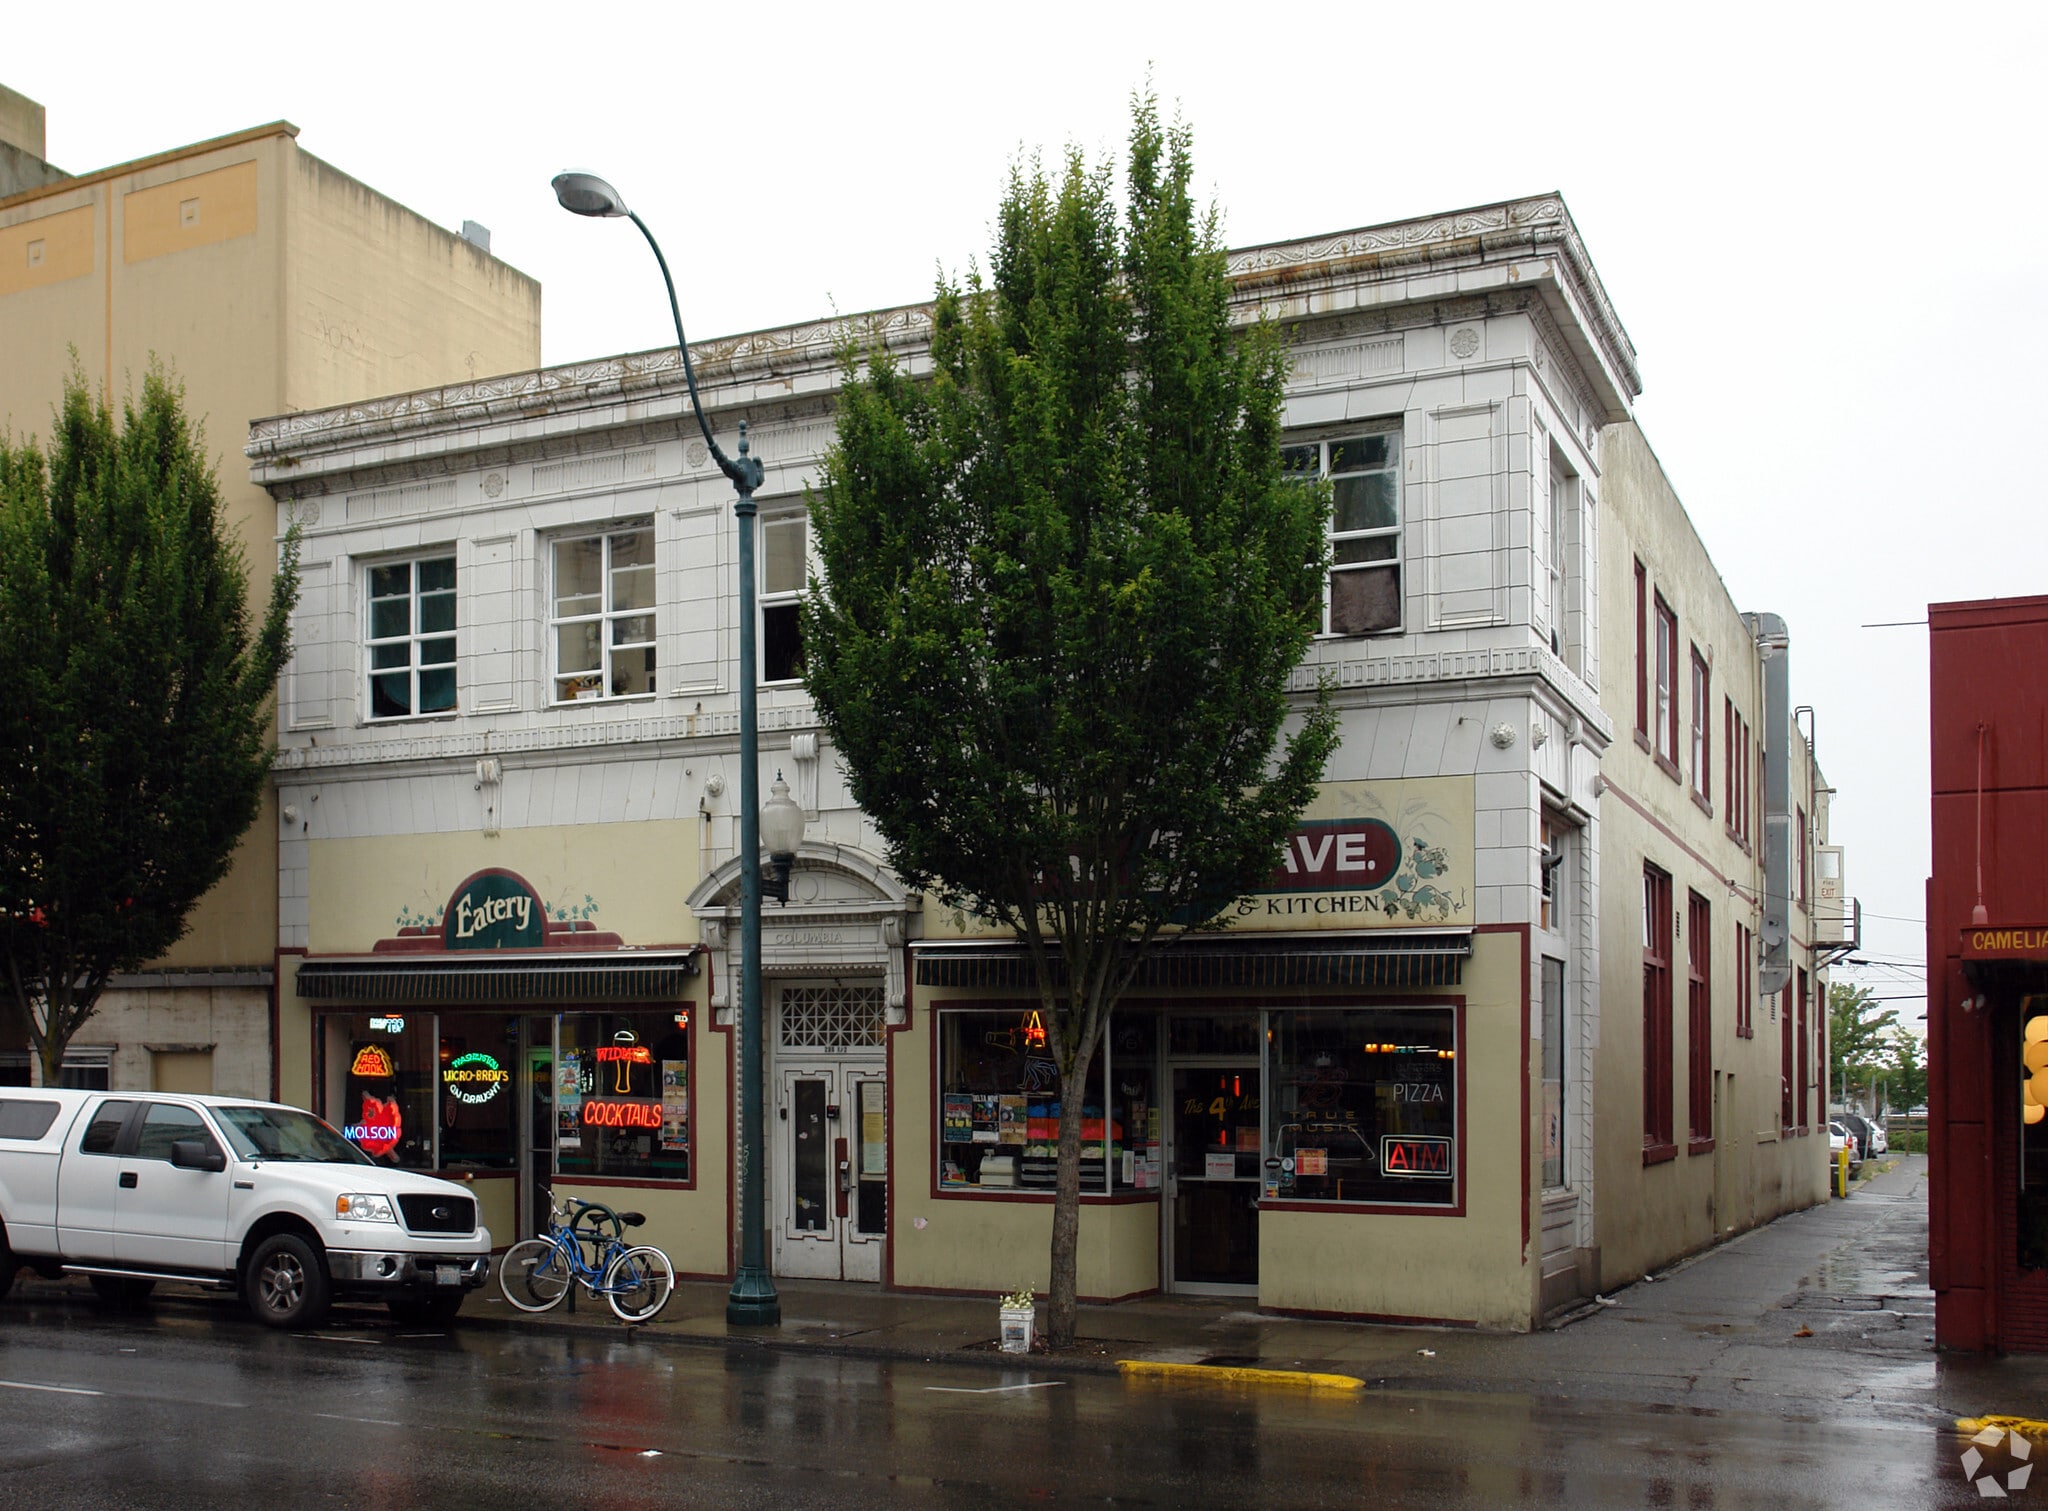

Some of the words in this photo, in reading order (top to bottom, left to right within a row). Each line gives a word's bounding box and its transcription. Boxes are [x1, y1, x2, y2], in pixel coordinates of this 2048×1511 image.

[1821, 887, 1836, 897] EXIT
[1266, 894, 1380, 915] KITCHEN
[455, 892, 532, 939] Eatery
[775, 930, 843, 945] COLUMBIA
[360, 1054, 381, 1064] RED
[596, 1045, 652, 1064] WIDMER
[356, 1063, 386, 1074] HOOK
[449, 1083, 463, 1099] ON
[462, 1081, 501, 1104] DRAUGHT
[1393, 1083, 1443, 1102] PIZZA
[585, 1101, 662, 1127] COCKTAILS
[344, 1126, 397, 1139] MOLSON
[1288, 1122, 1359, 1133] MUSIC
[1389, 1142, 1447, 1171] ATM
